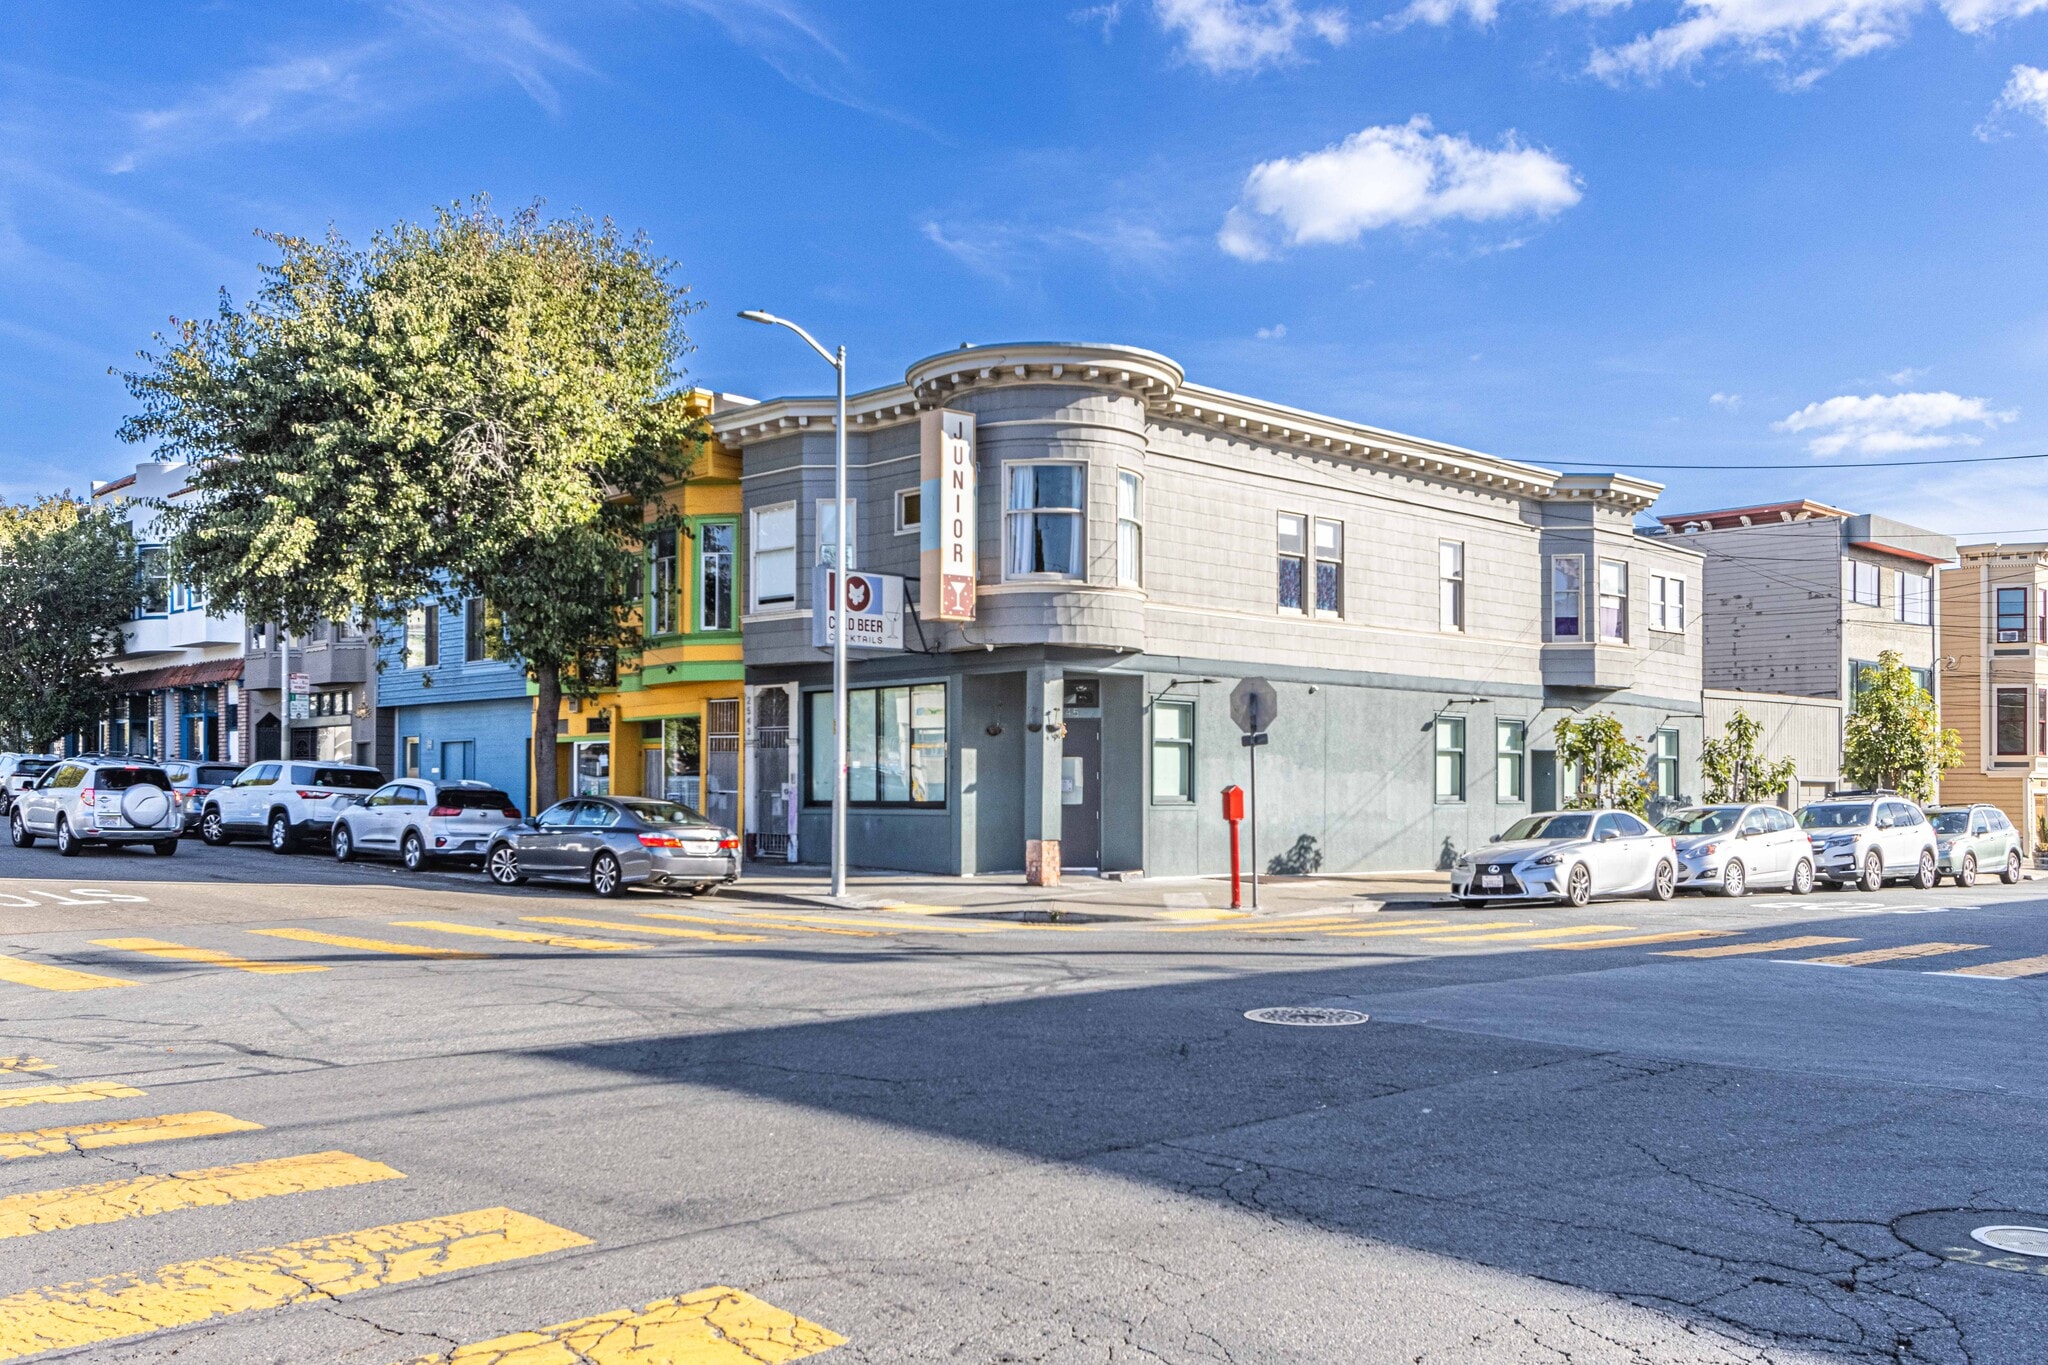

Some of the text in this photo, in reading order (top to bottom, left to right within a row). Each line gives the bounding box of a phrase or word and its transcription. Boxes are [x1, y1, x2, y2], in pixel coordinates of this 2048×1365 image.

[952, 421, 963, 562] JUNIOR
[829, 616, 883, 632] CD BEER
[829, 633, 883, 644] CKTAILS
